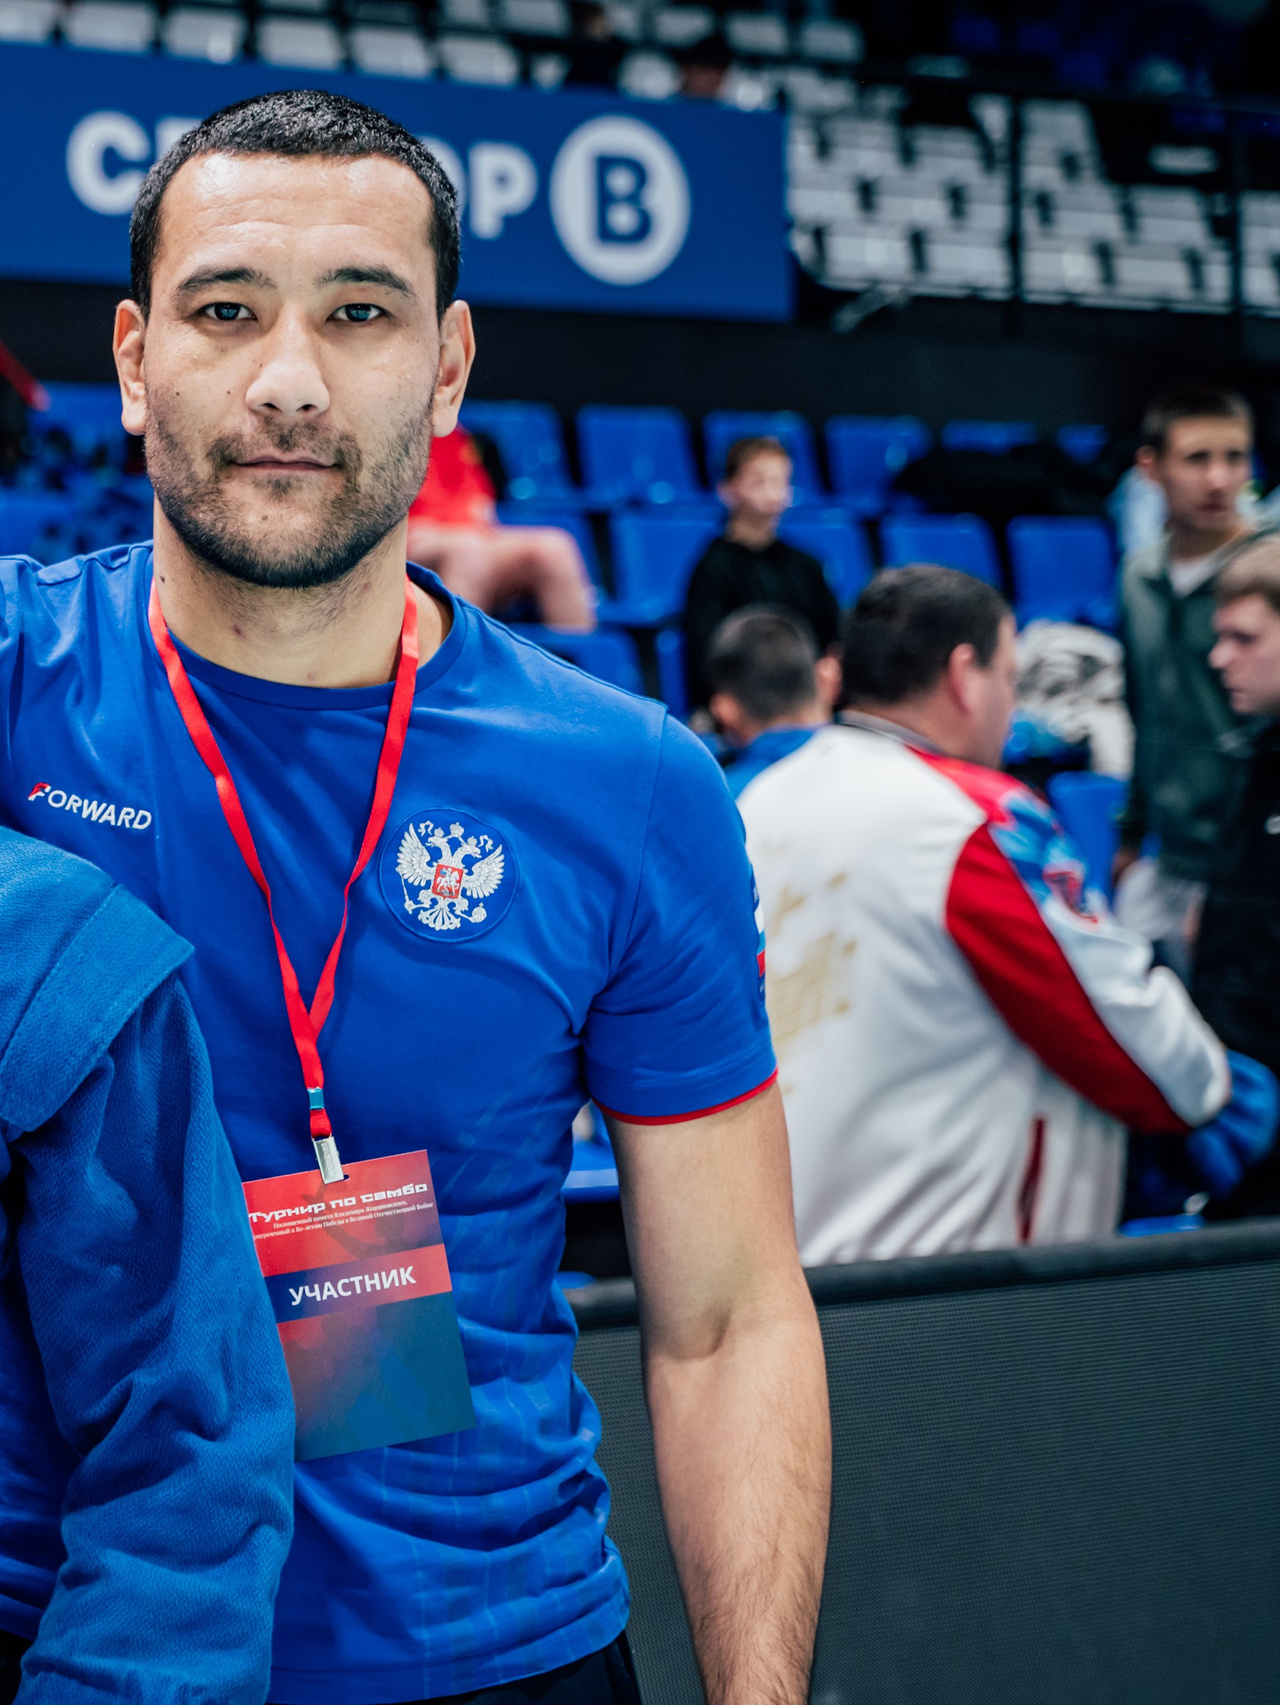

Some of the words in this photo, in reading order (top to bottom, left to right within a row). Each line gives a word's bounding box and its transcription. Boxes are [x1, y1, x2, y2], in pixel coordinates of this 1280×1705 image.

[28, 782, 152, 830] FORWARD
[329, 1196, 357, 1209] по
[360, 1183, 427, 1203] самбо
[288, 1265, 417, 1306] УЧАСТНИК
